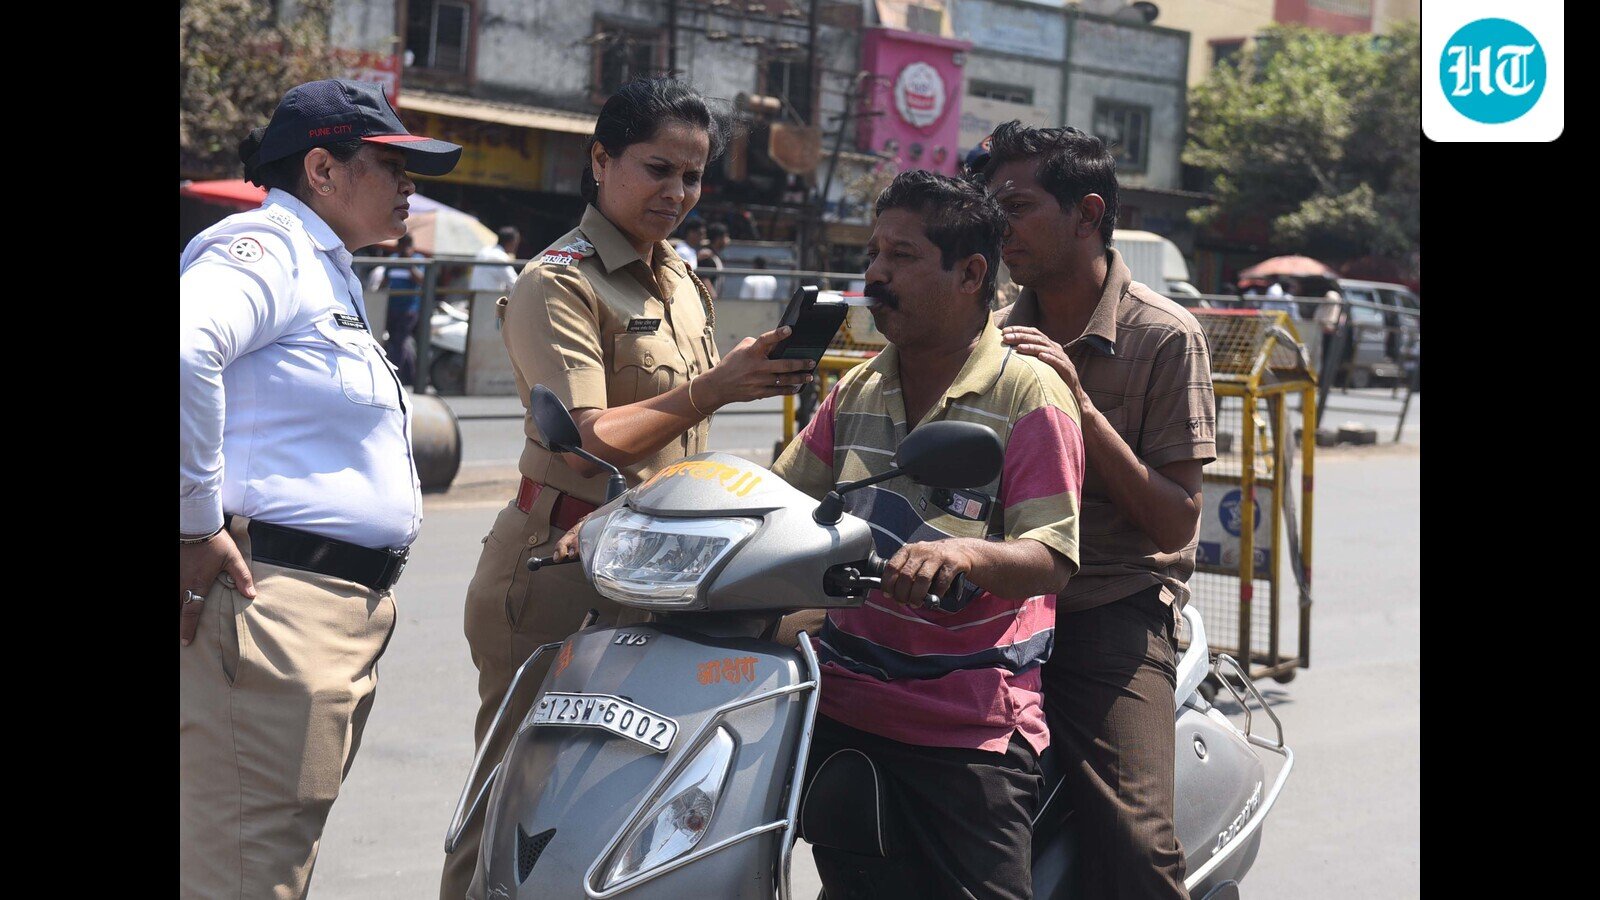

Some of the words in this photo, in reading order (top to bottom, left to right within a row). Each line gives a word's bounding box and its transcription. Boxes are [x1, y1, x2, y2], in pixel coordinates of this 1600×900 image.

[309, 128, 331, 137] PUNE
[333, 124, 352, 134] CITY
[615, 632, 650, 646] TVS
[603, 703, 667, 744] 6002
